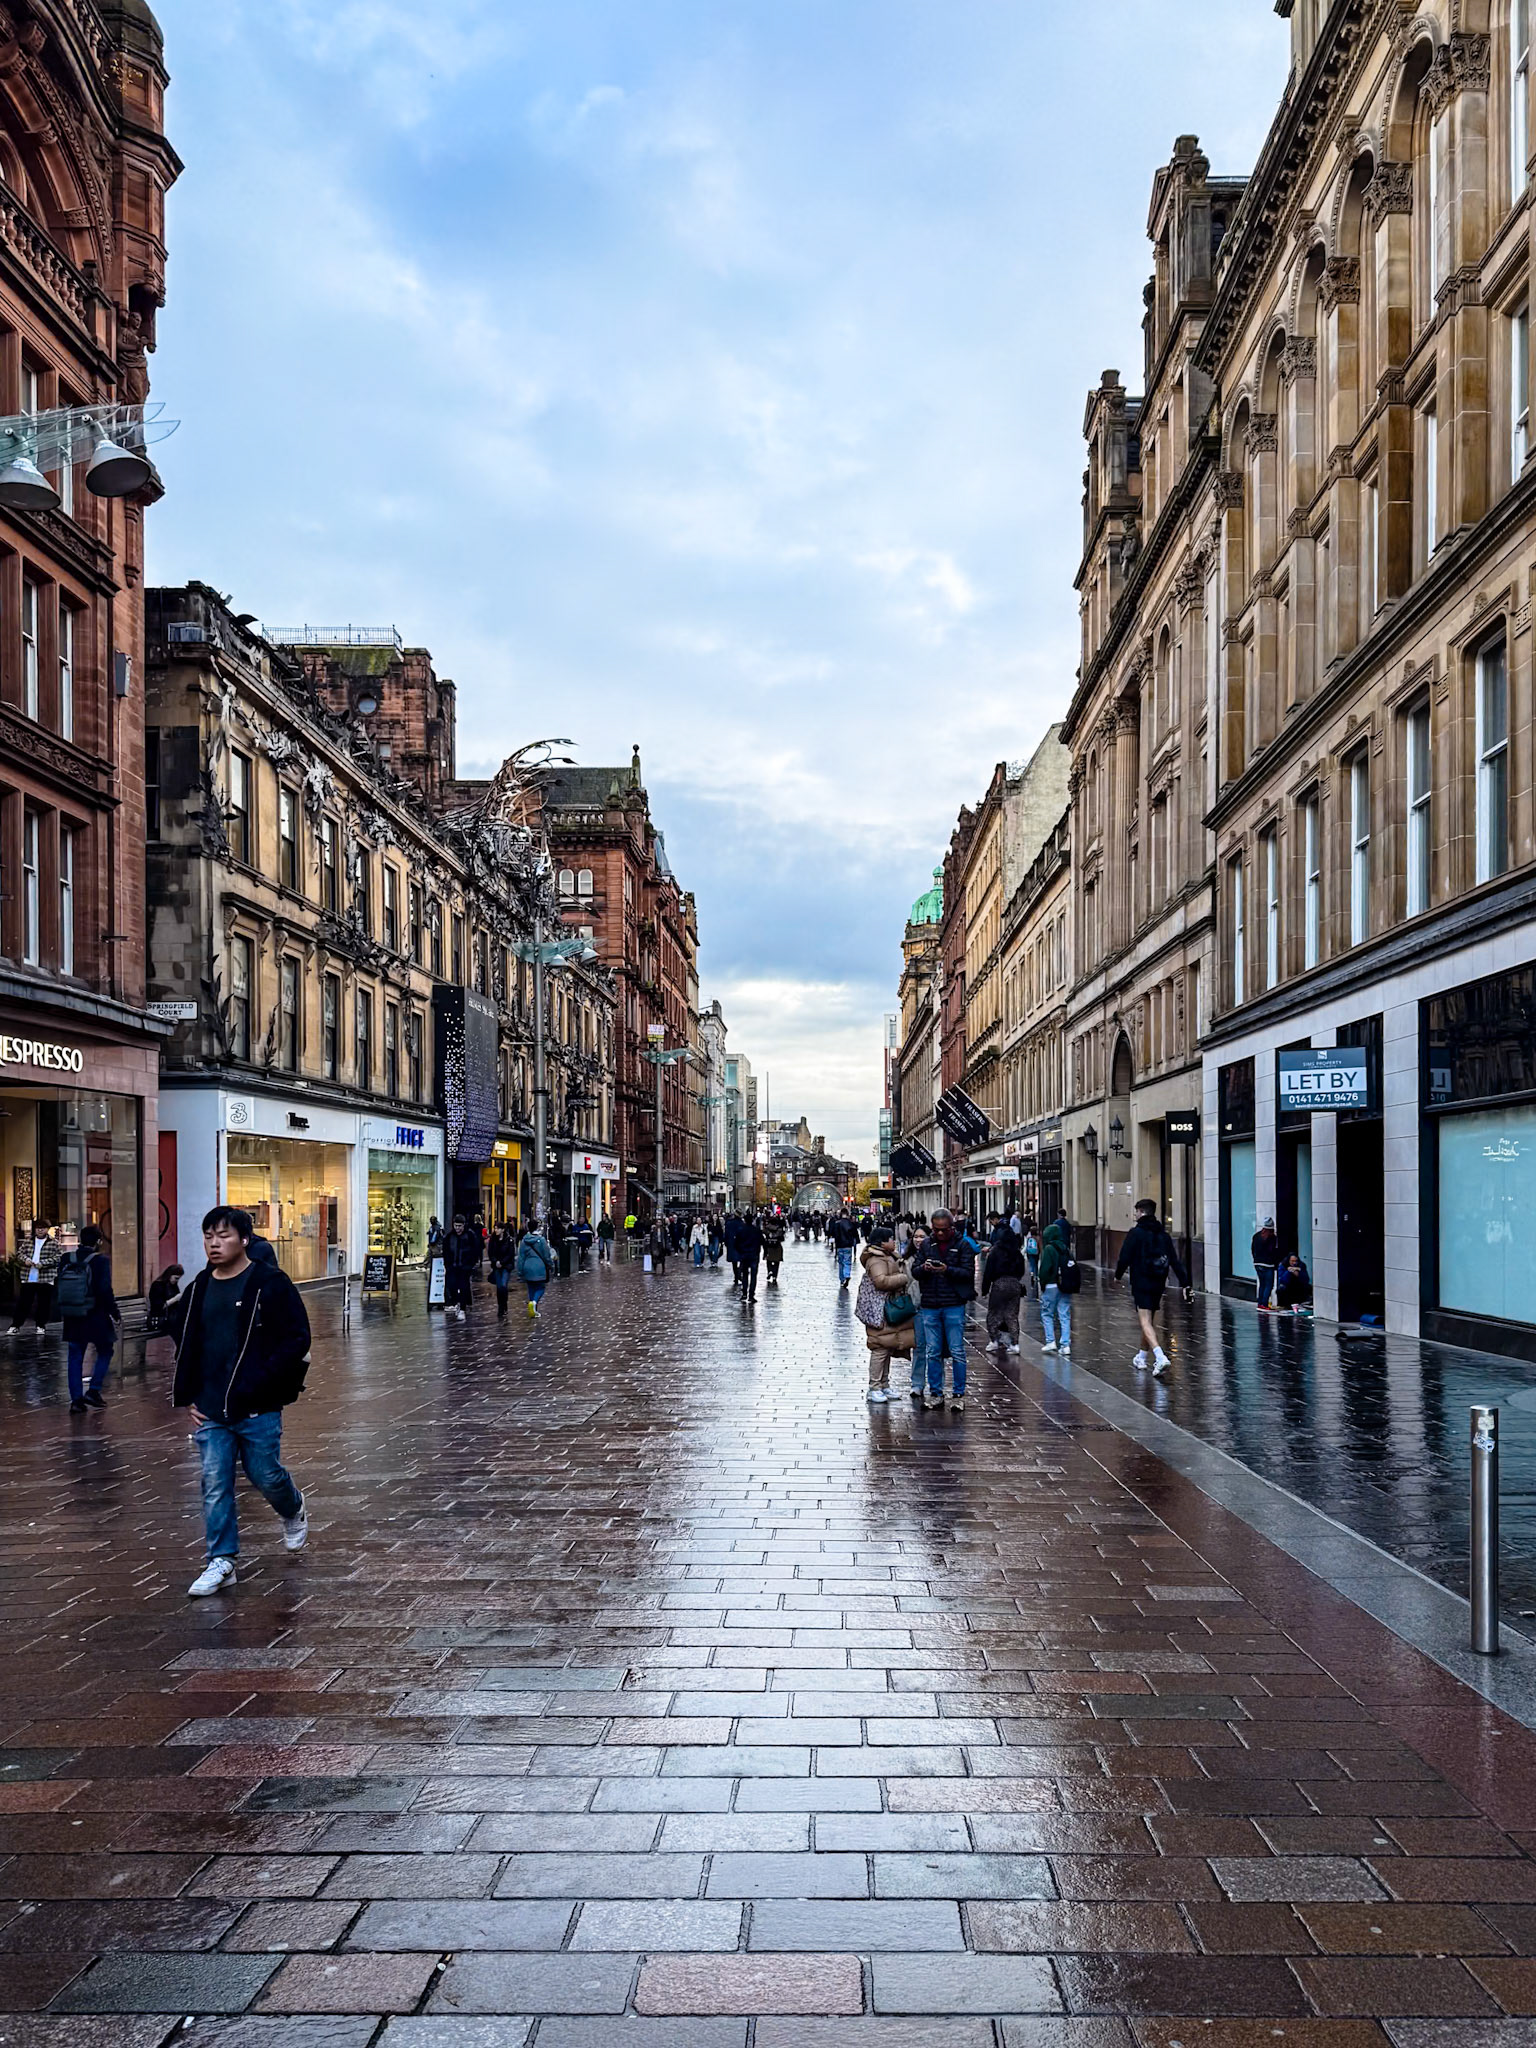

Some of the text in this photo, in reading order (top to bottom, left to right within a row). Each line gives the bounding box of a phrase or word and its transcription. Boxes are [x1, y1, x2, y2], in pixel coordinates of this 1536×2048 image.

[0, 1034, 83, 1072] ESPRESSO
[1288, 1072, 1357, 1090] LET BY
[1289, 1093, 1358, 1104] 0141 471 9476
[1170, 1123, 1193, 1131] BOSS
